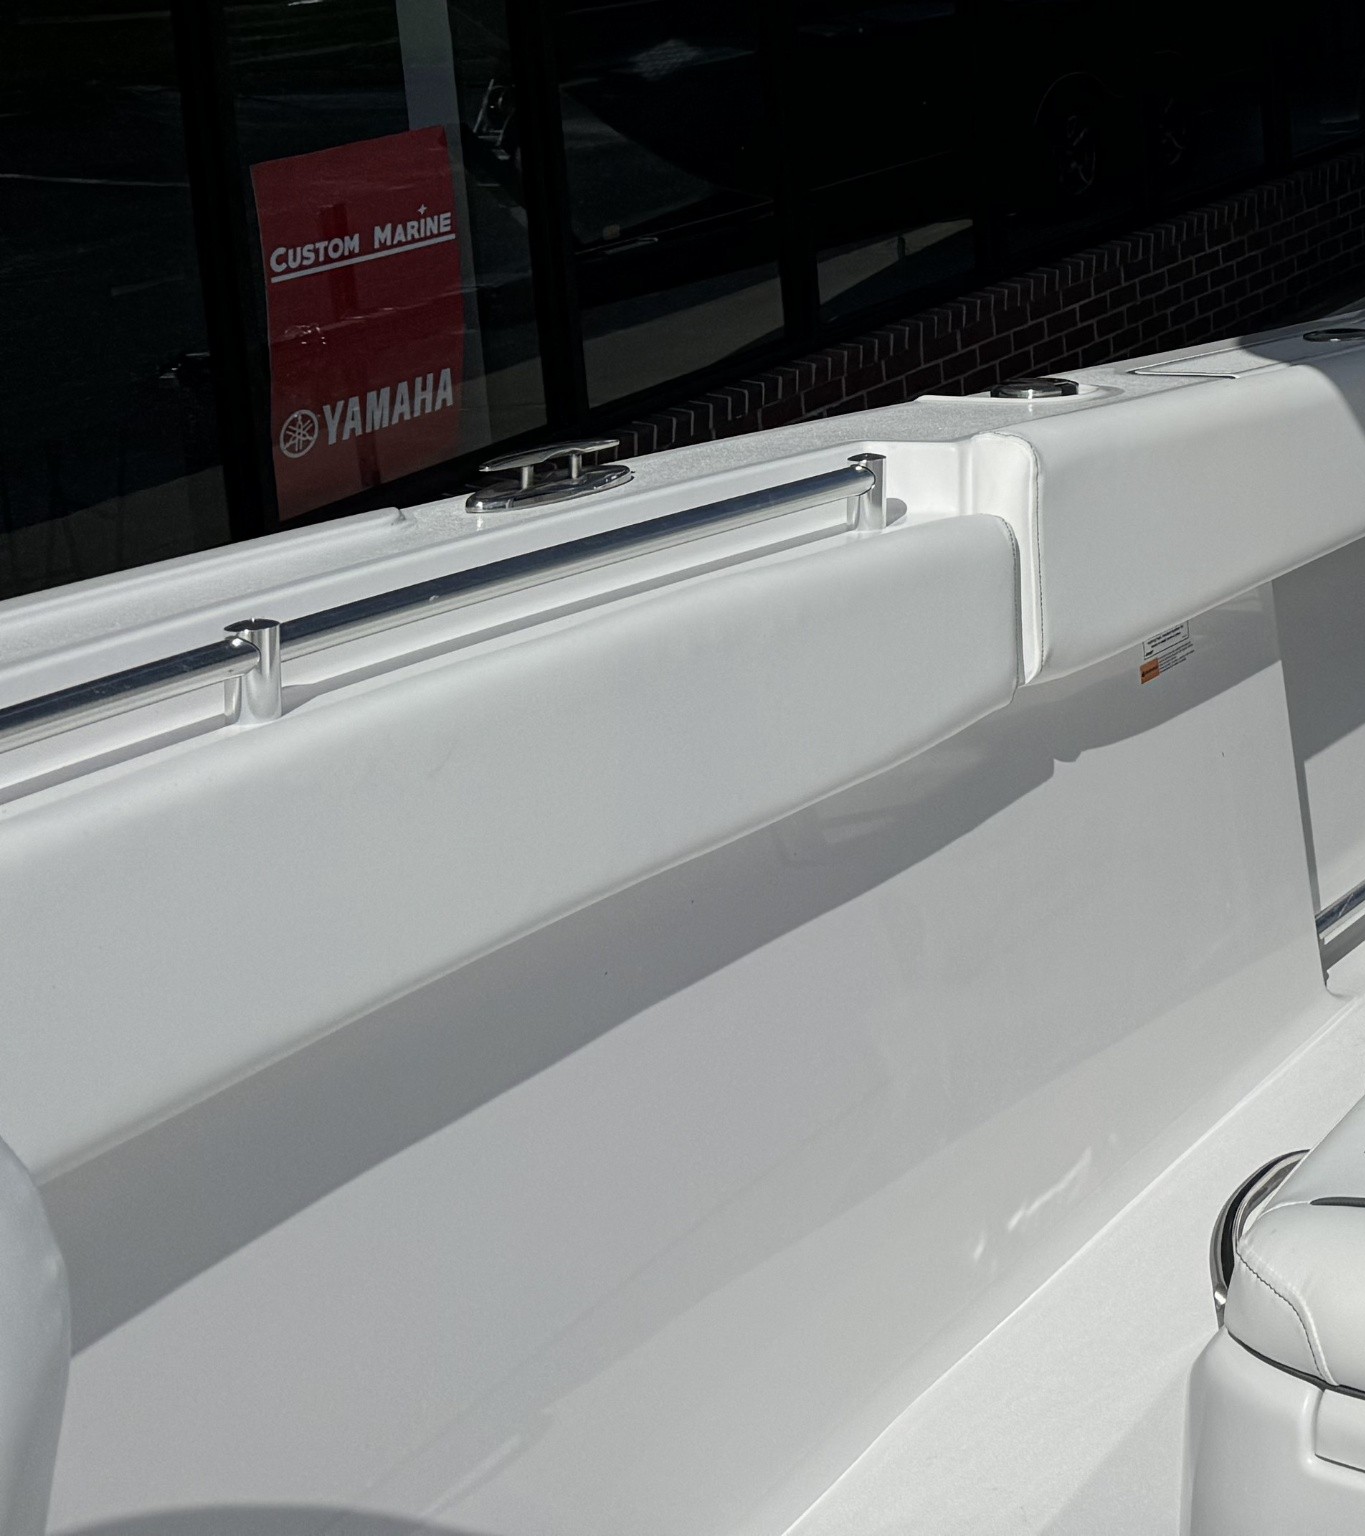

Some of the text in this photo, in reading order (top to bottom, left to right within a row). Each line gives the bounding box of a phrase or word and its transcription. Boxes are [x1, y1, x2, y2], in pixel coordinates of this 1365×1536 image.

[269, 210, 453, 273] CUSTOM MARINE
[322, 367, 454, 446] YAMAHA
